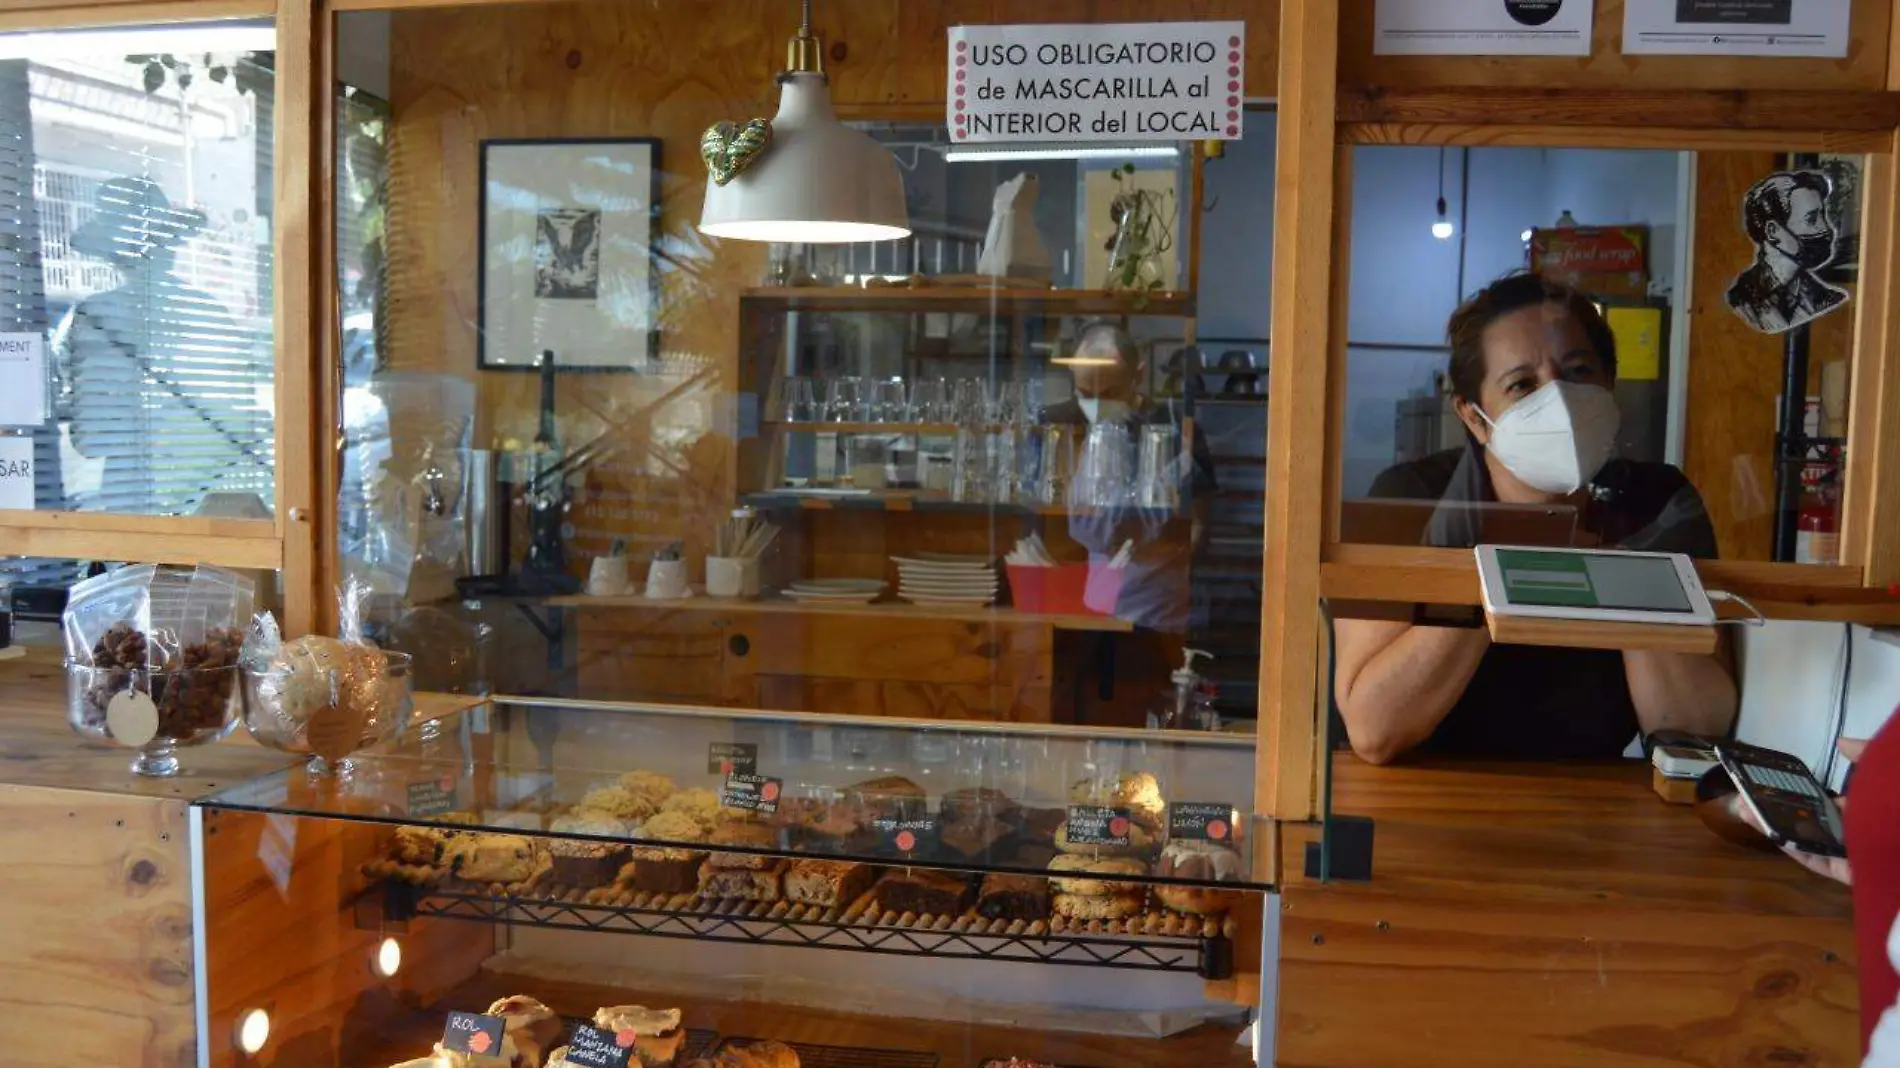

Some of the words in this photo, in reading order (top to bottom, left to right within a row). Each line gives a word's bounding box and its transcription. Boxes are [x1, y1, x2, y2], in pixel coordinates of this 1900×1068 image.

[972, 44, 1028, 66] USO
[1037, 42, 1216, 65] OBLIGATORIO
[977, 77, 1005, 100] de
[1015, 77, 1178, 100] MASCARILLA
[1188, 75, 1209, 97] al
[966, 112, 1081, 134] INTERIOR
[1092, 110, 1126, 133] del
[1137, 110, 1220, 133] LOCAL
[451, 1016, 480, 1032] ROL
